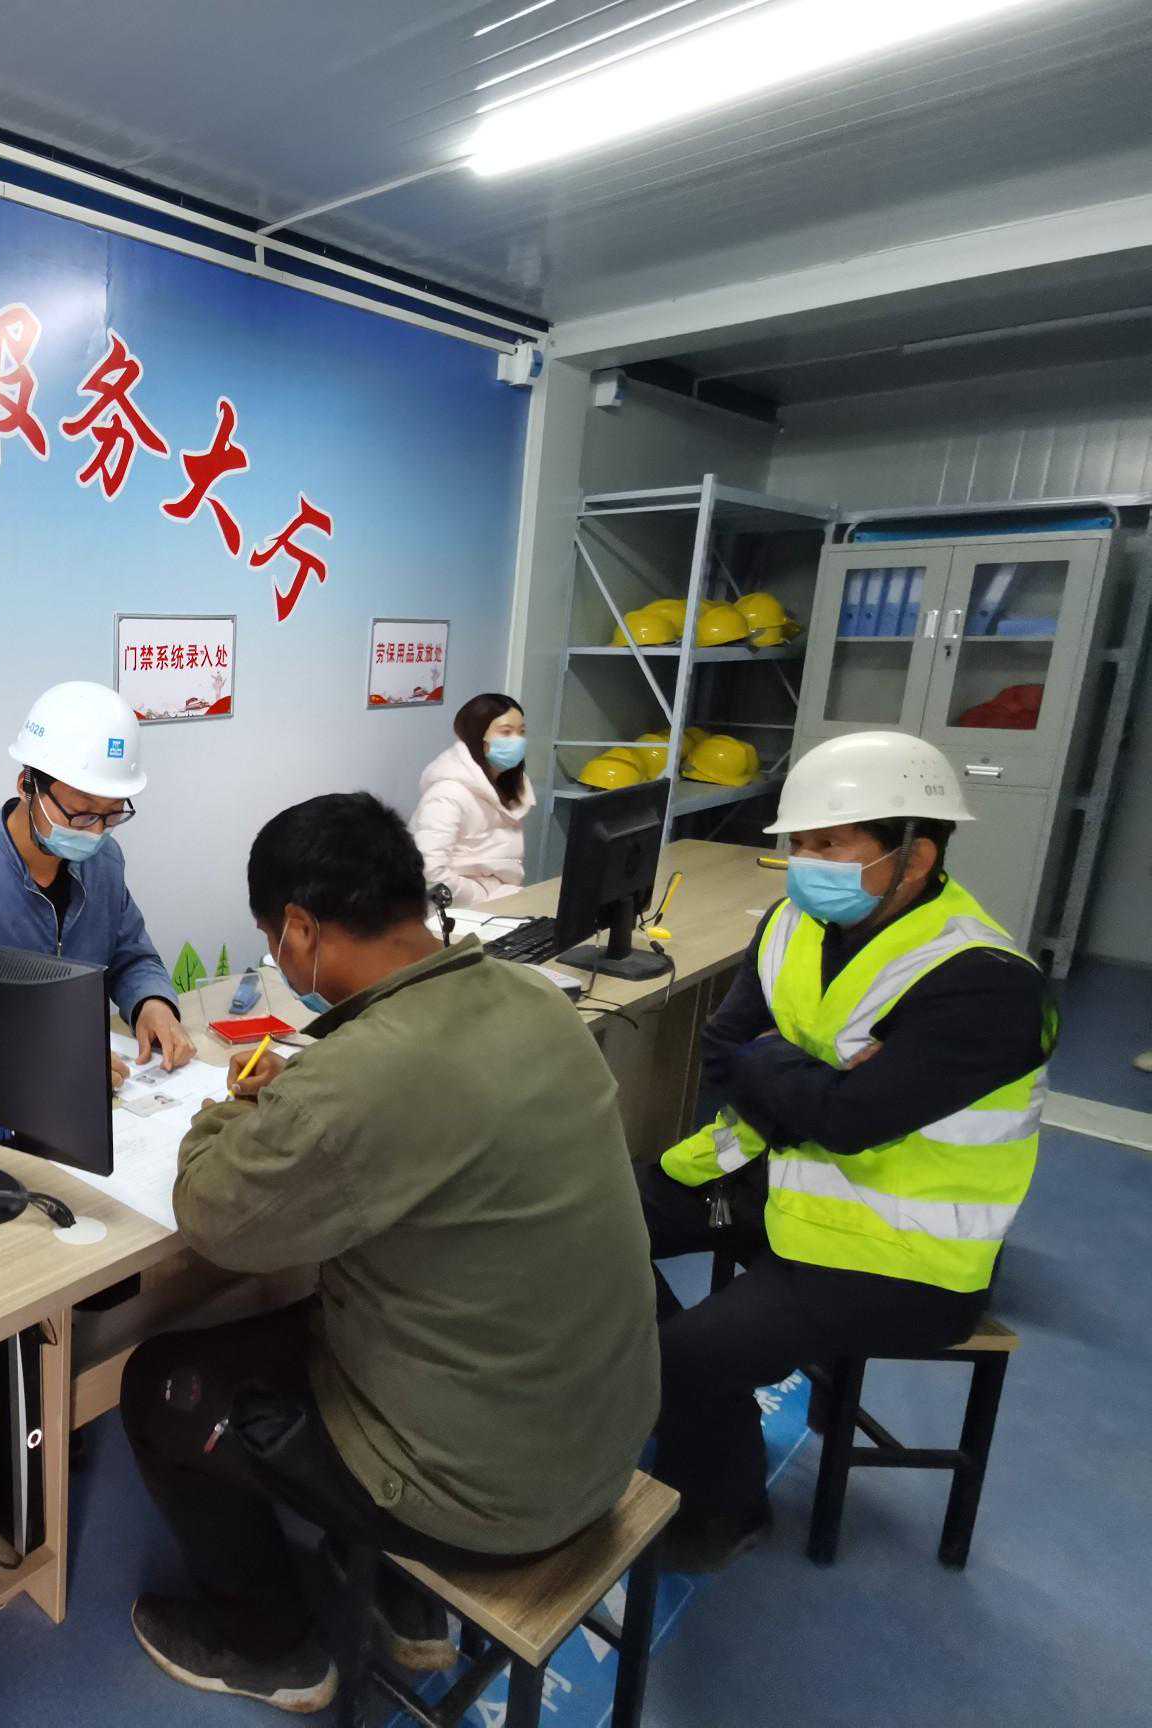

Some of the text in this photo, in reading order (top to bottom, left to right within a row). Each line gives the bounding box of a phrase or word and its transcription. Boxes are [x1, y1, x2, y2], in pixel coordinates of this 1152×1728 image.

[124, 644, 228, 671] 门禁系统录入处
